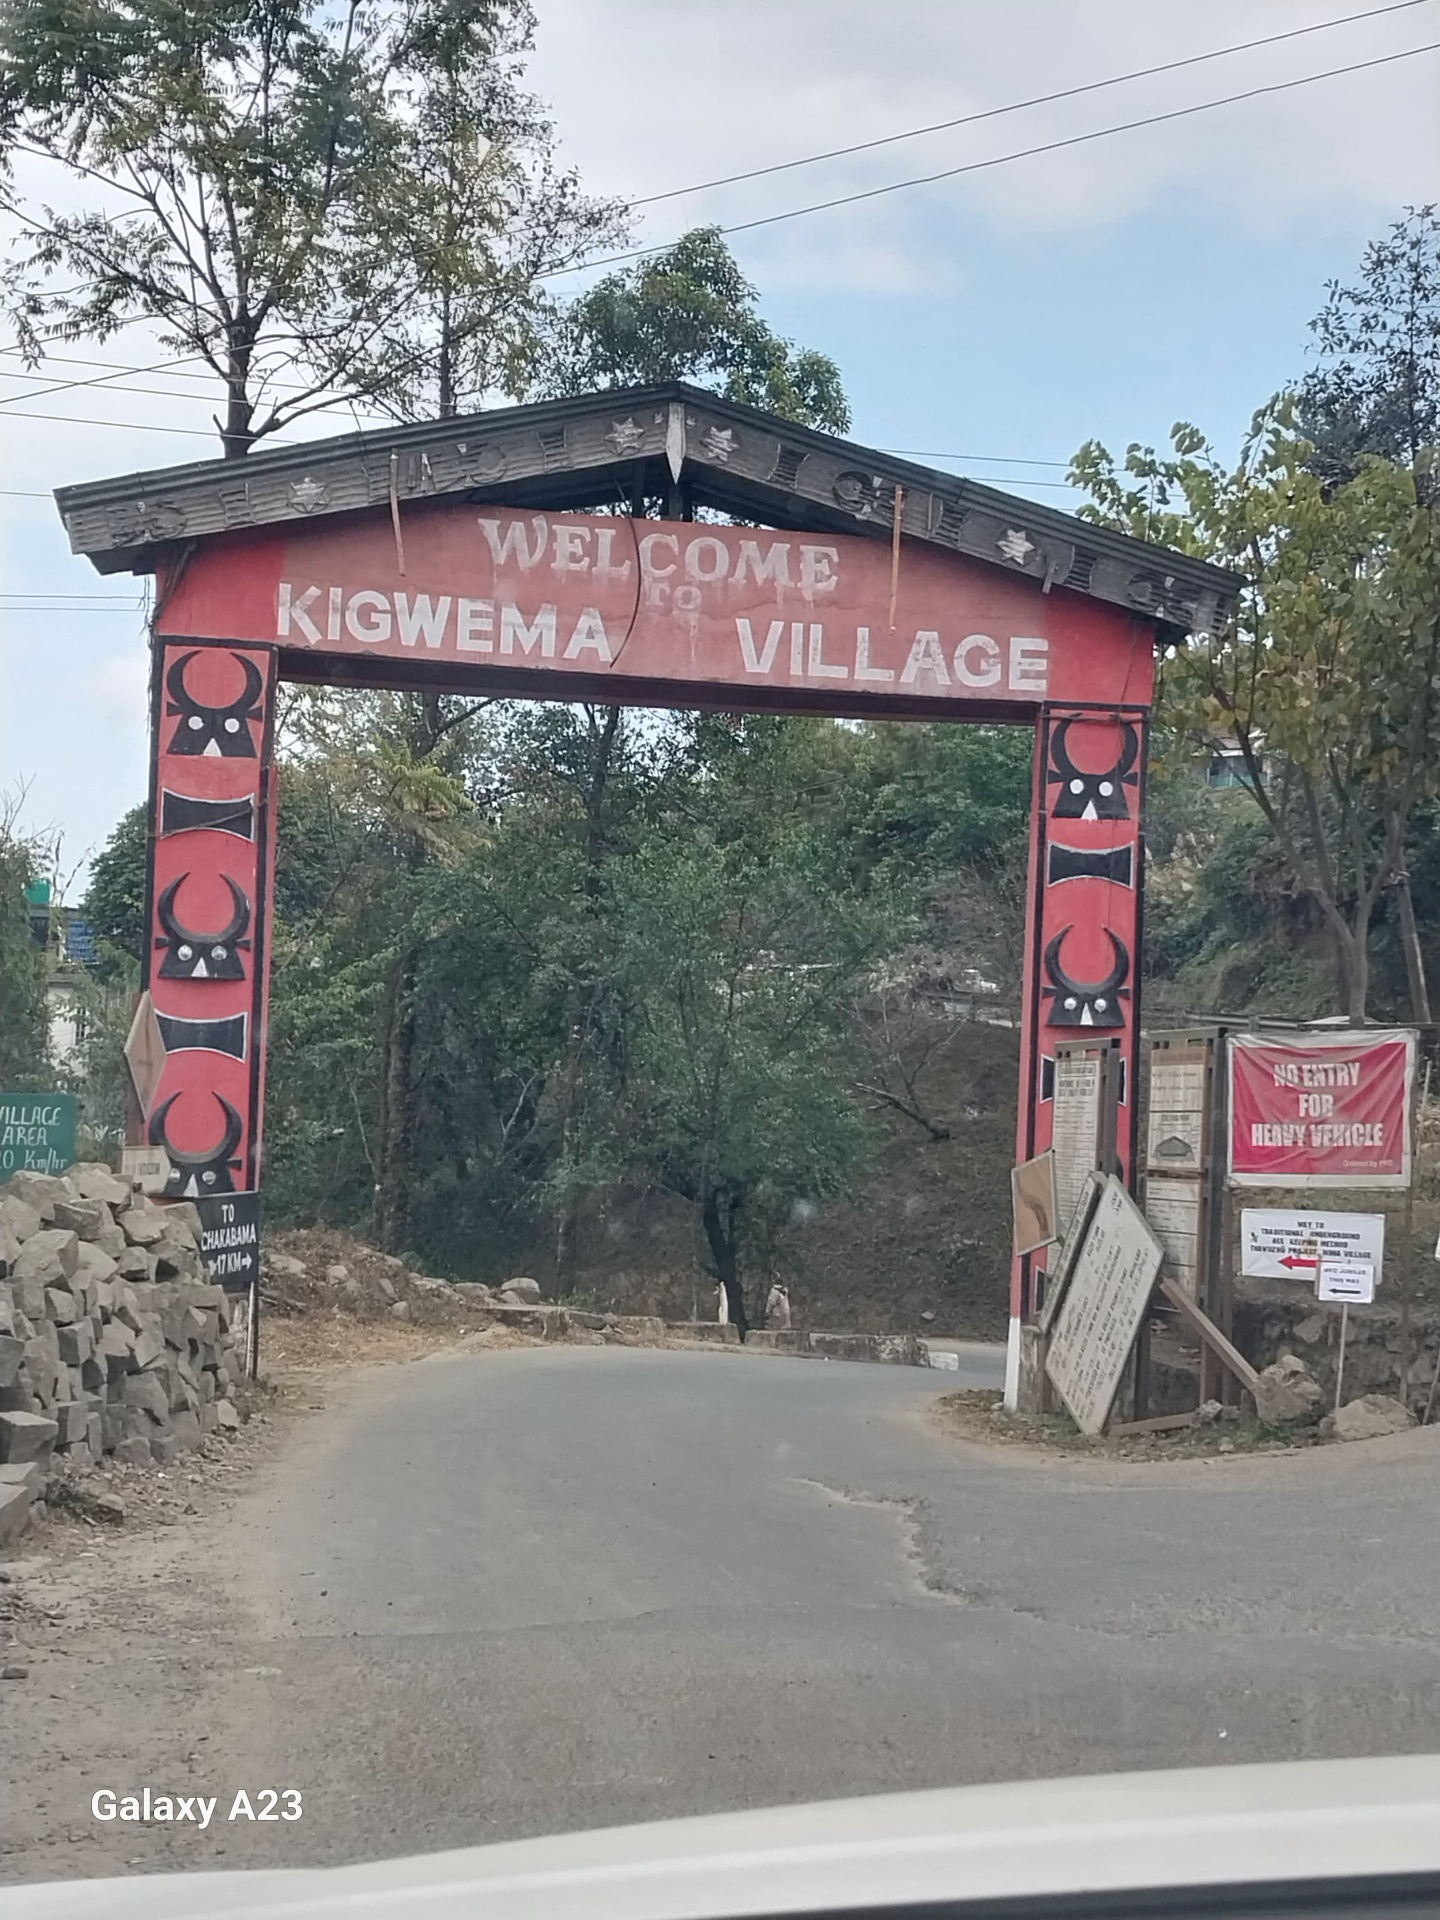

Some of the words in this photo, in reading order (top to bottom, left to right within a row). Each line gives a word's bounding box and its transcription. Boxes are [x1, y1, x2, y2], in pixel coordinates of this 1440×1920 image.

[478, 514, 839, 592] WELCOME
[277, 582, 613, 662] KIGWEMA
[735, 618, 1048, 691] VILLAGE
[1273, 1064, 1299, 1087] NO
[1303, 1062, 1360, 1087] ENTRY
[1298, 1094, 1334, 1117] FOR
[1, 1126, 48, 1146] AREA
[1251, 1123, 1306, 1147] HEAVY
[1309, 1123, 1383, 1147] VEHICLE
[0, 1149, 14, 1169] 0
[221, 1204, 234, 1224] TO
[201, 1222, 256, 1251] CHAKABAMA
